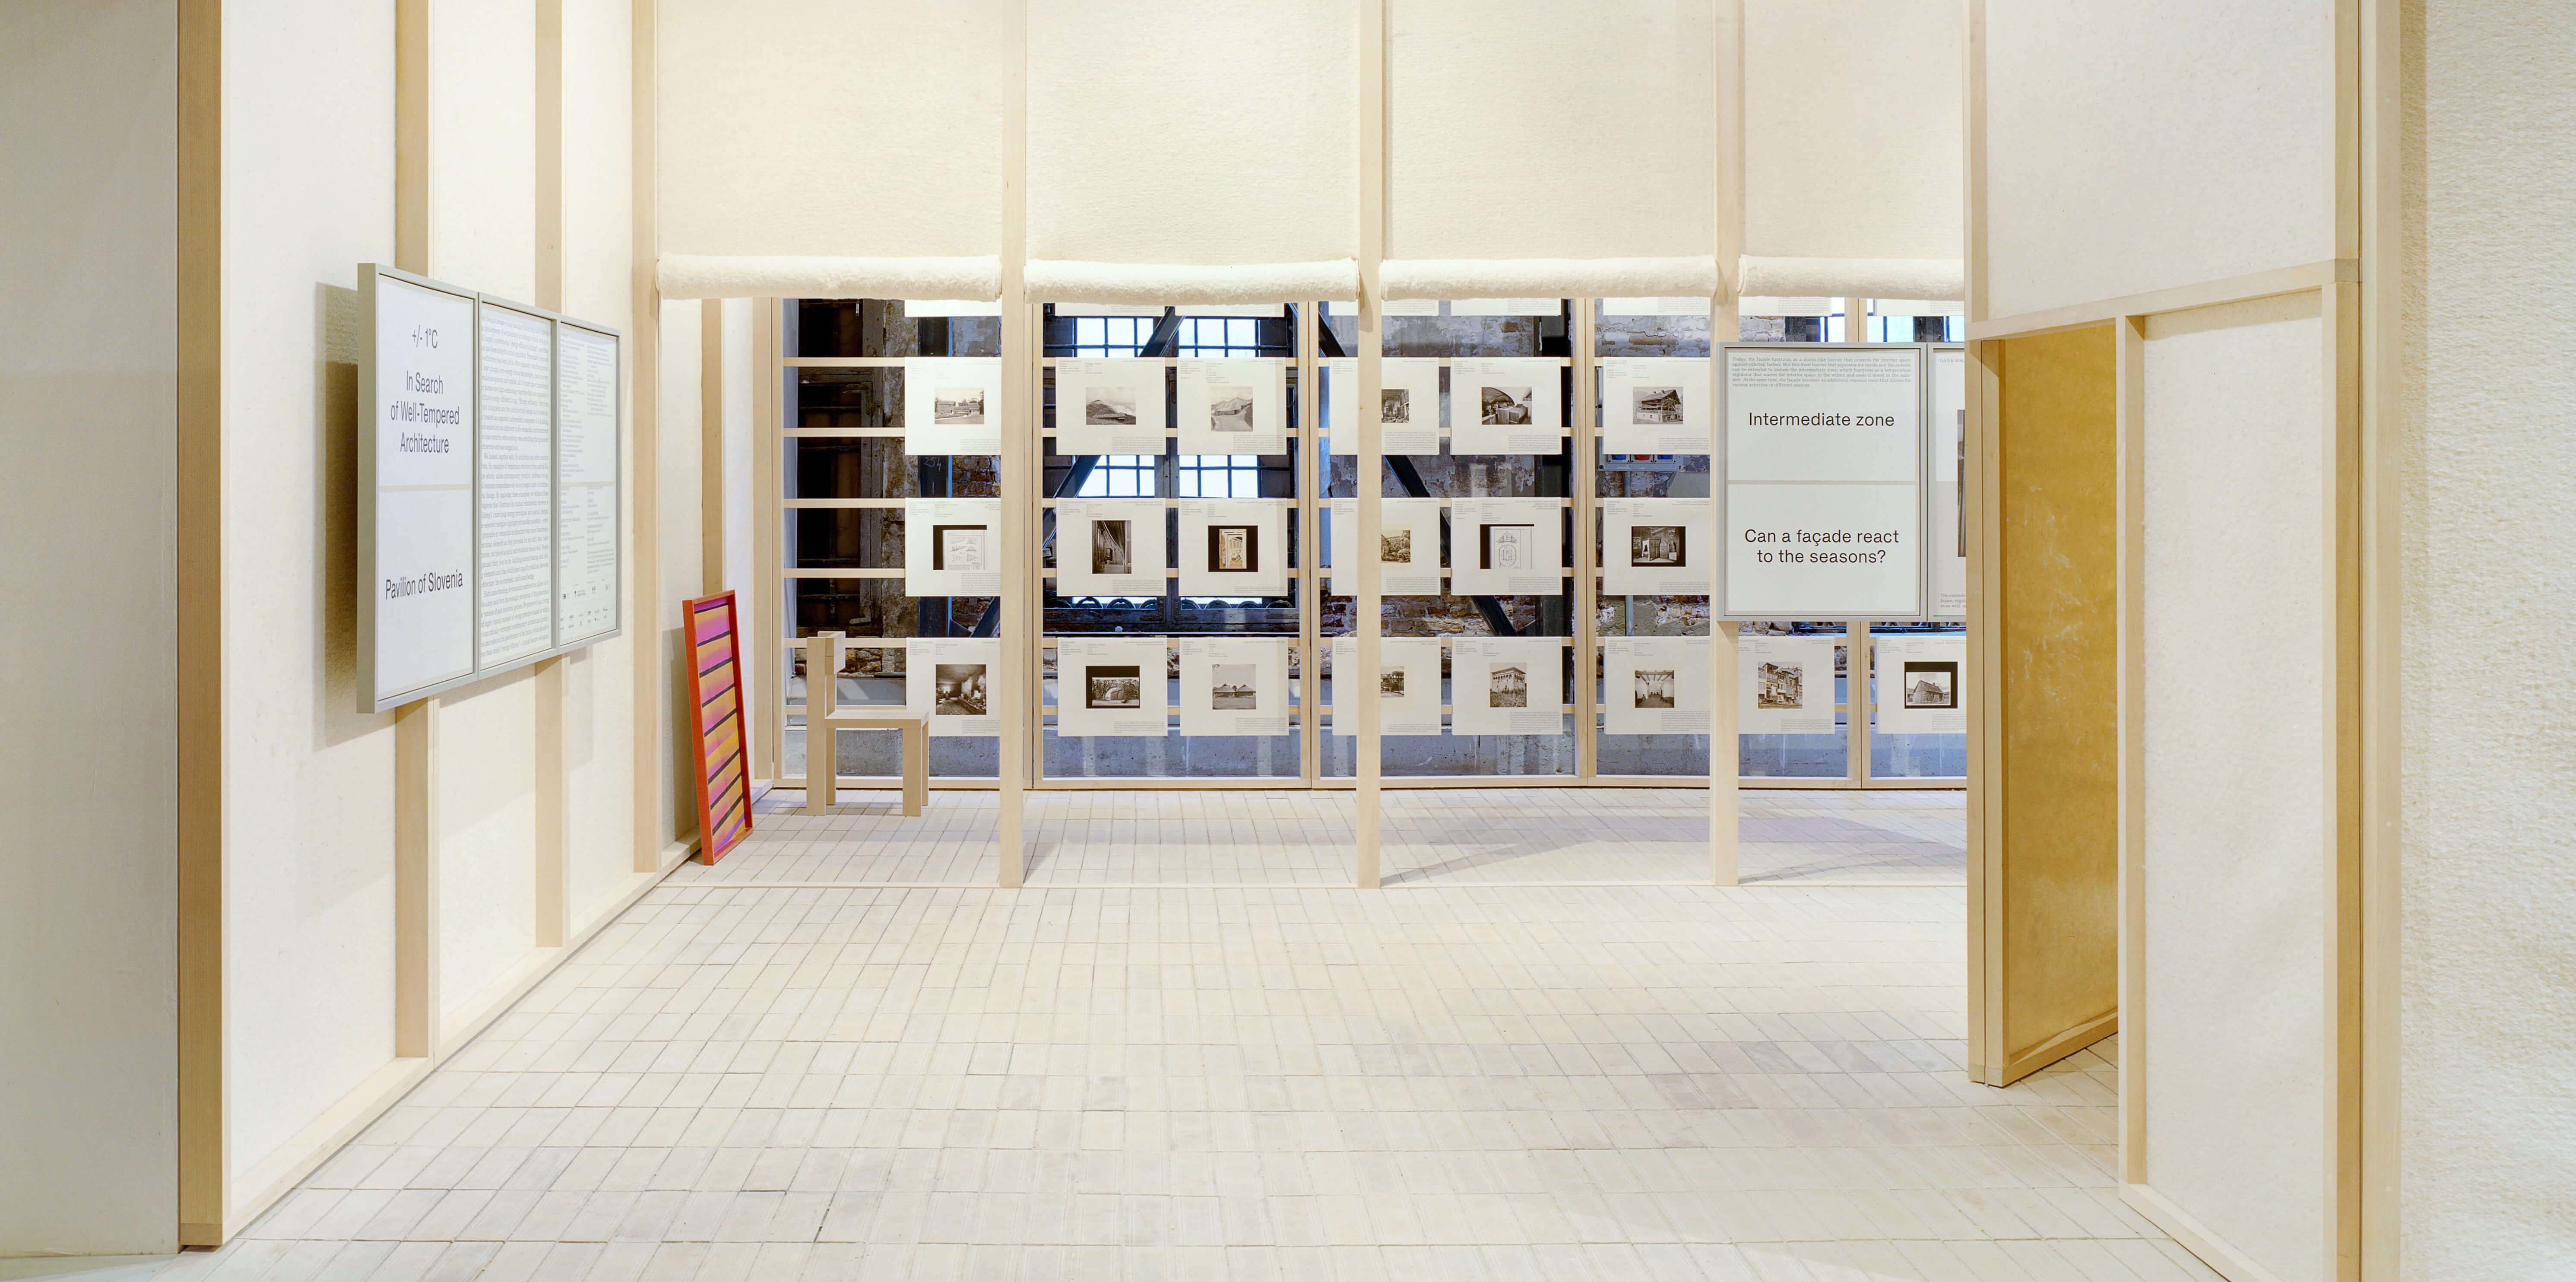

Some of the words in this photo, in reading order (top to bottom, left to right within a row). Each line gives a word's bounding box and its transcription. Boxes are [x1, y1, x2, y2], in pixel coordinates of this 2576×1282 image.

[407, 370, 413, 390] In
[415, 372, 443, 394] Search
[391, 401, 399, 420] of
[401, 401, 459, 428] Well-Tempered
[1749, 412, 1850, 426] Intermediate
[1856, 416, 1894, 426] zone
[400, 432, 449, 453] Architecture
[1745, 529, 1776, 543] Can
[1782, 532, 1791, 543] a
[1797, 529, 1851, 546] façade
[1857, 530, 1899, 543] react
[1757, 550, 1773, 563] to
[1778, 549, 1804, 563] the
[1810, 549, 1886, 563] seasons?
[386, 577, 416, 600] Pavilion
[418, 574, 426, 593] of
[428, 569, 463, 592] Slovenia
